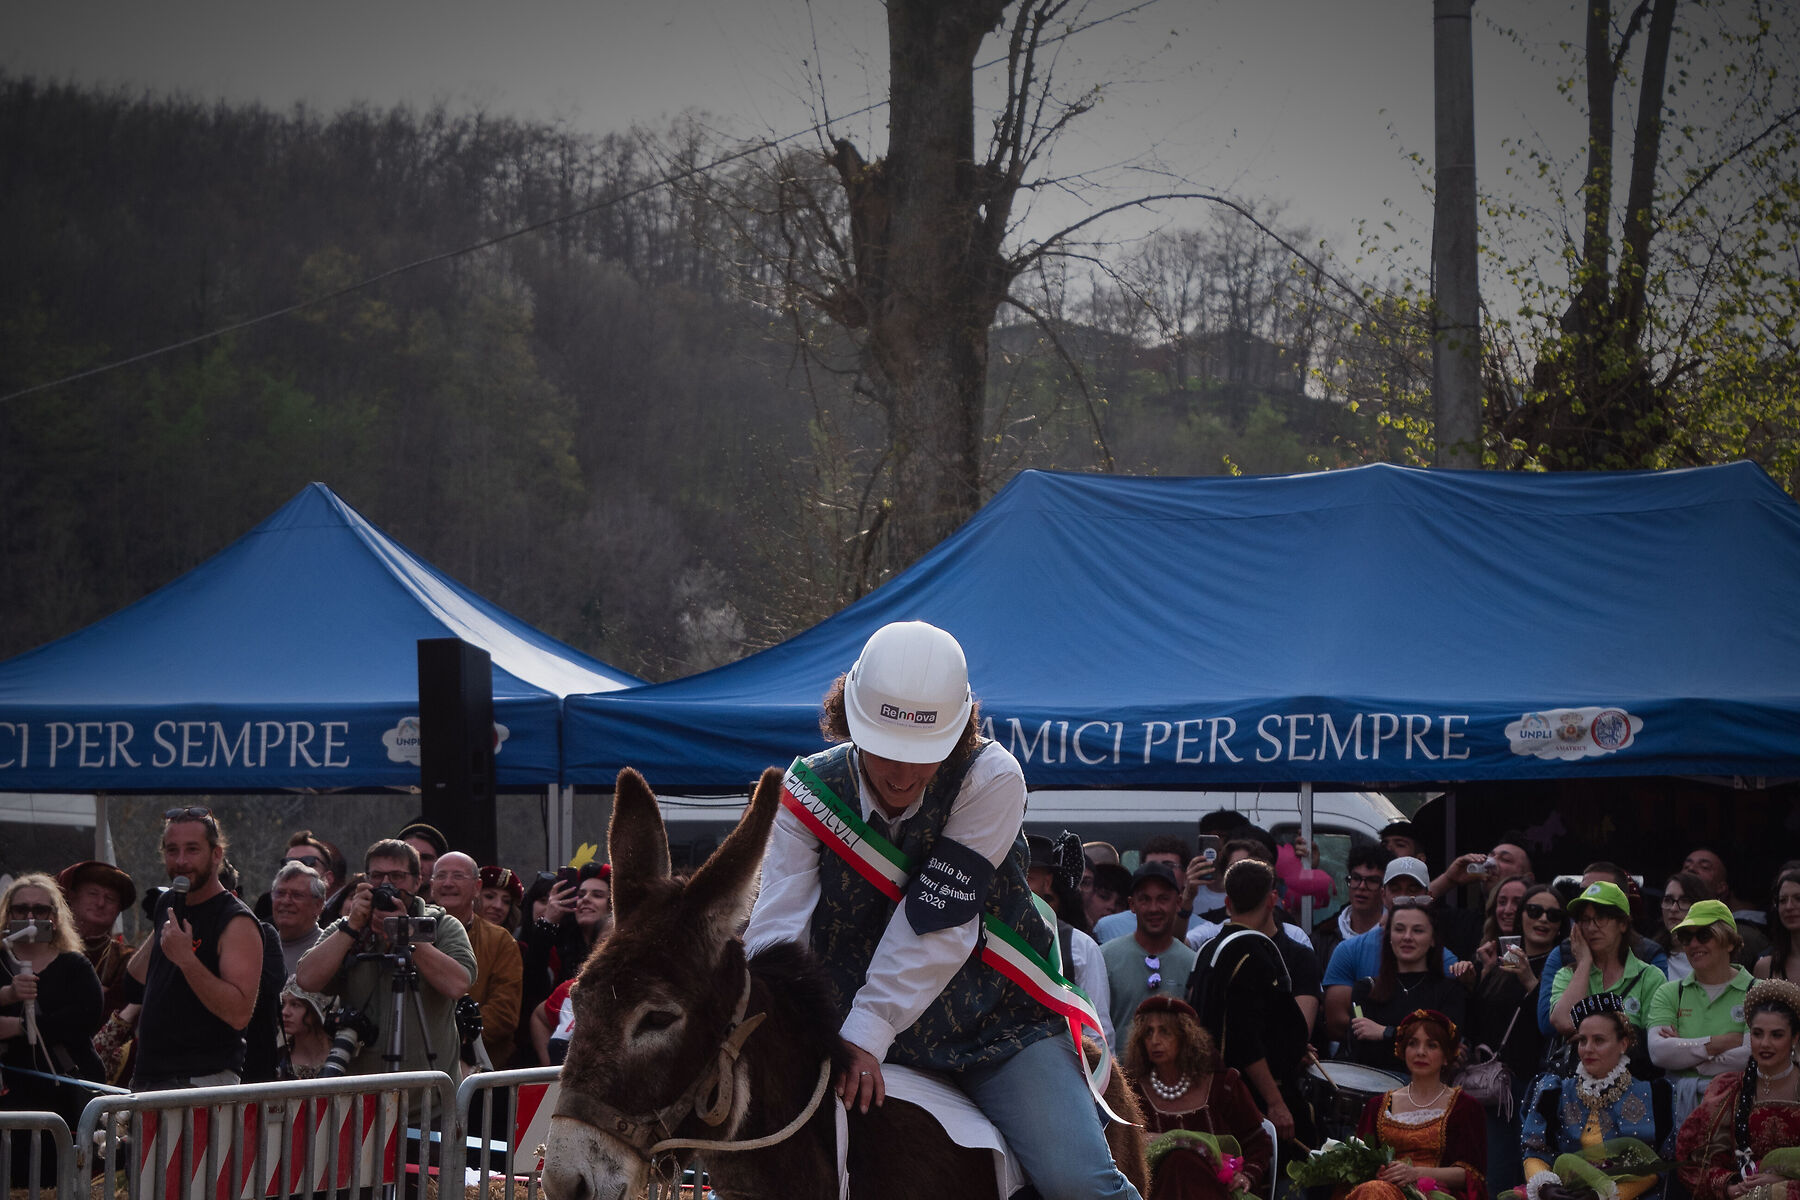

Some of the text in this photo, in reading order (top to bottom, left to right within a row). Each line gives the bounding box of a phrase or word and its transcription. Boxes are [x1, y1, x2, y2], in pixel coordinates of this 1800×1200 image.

[882, 705, 936, 722] Rennova
[45, 721, 142, 768] PER
[152, 720, 350, 768] SEMPRE
[1141, 716, 1244, 765] PER
[1256, 713, 1470, 763] SEMPRE
[1520, 729, 1552, 739] UNPLI
[928, 857, 972, 885] Palio dei
[918, 890, 946, 910] 2026
[938, 884, 977, 901] Sindaci
